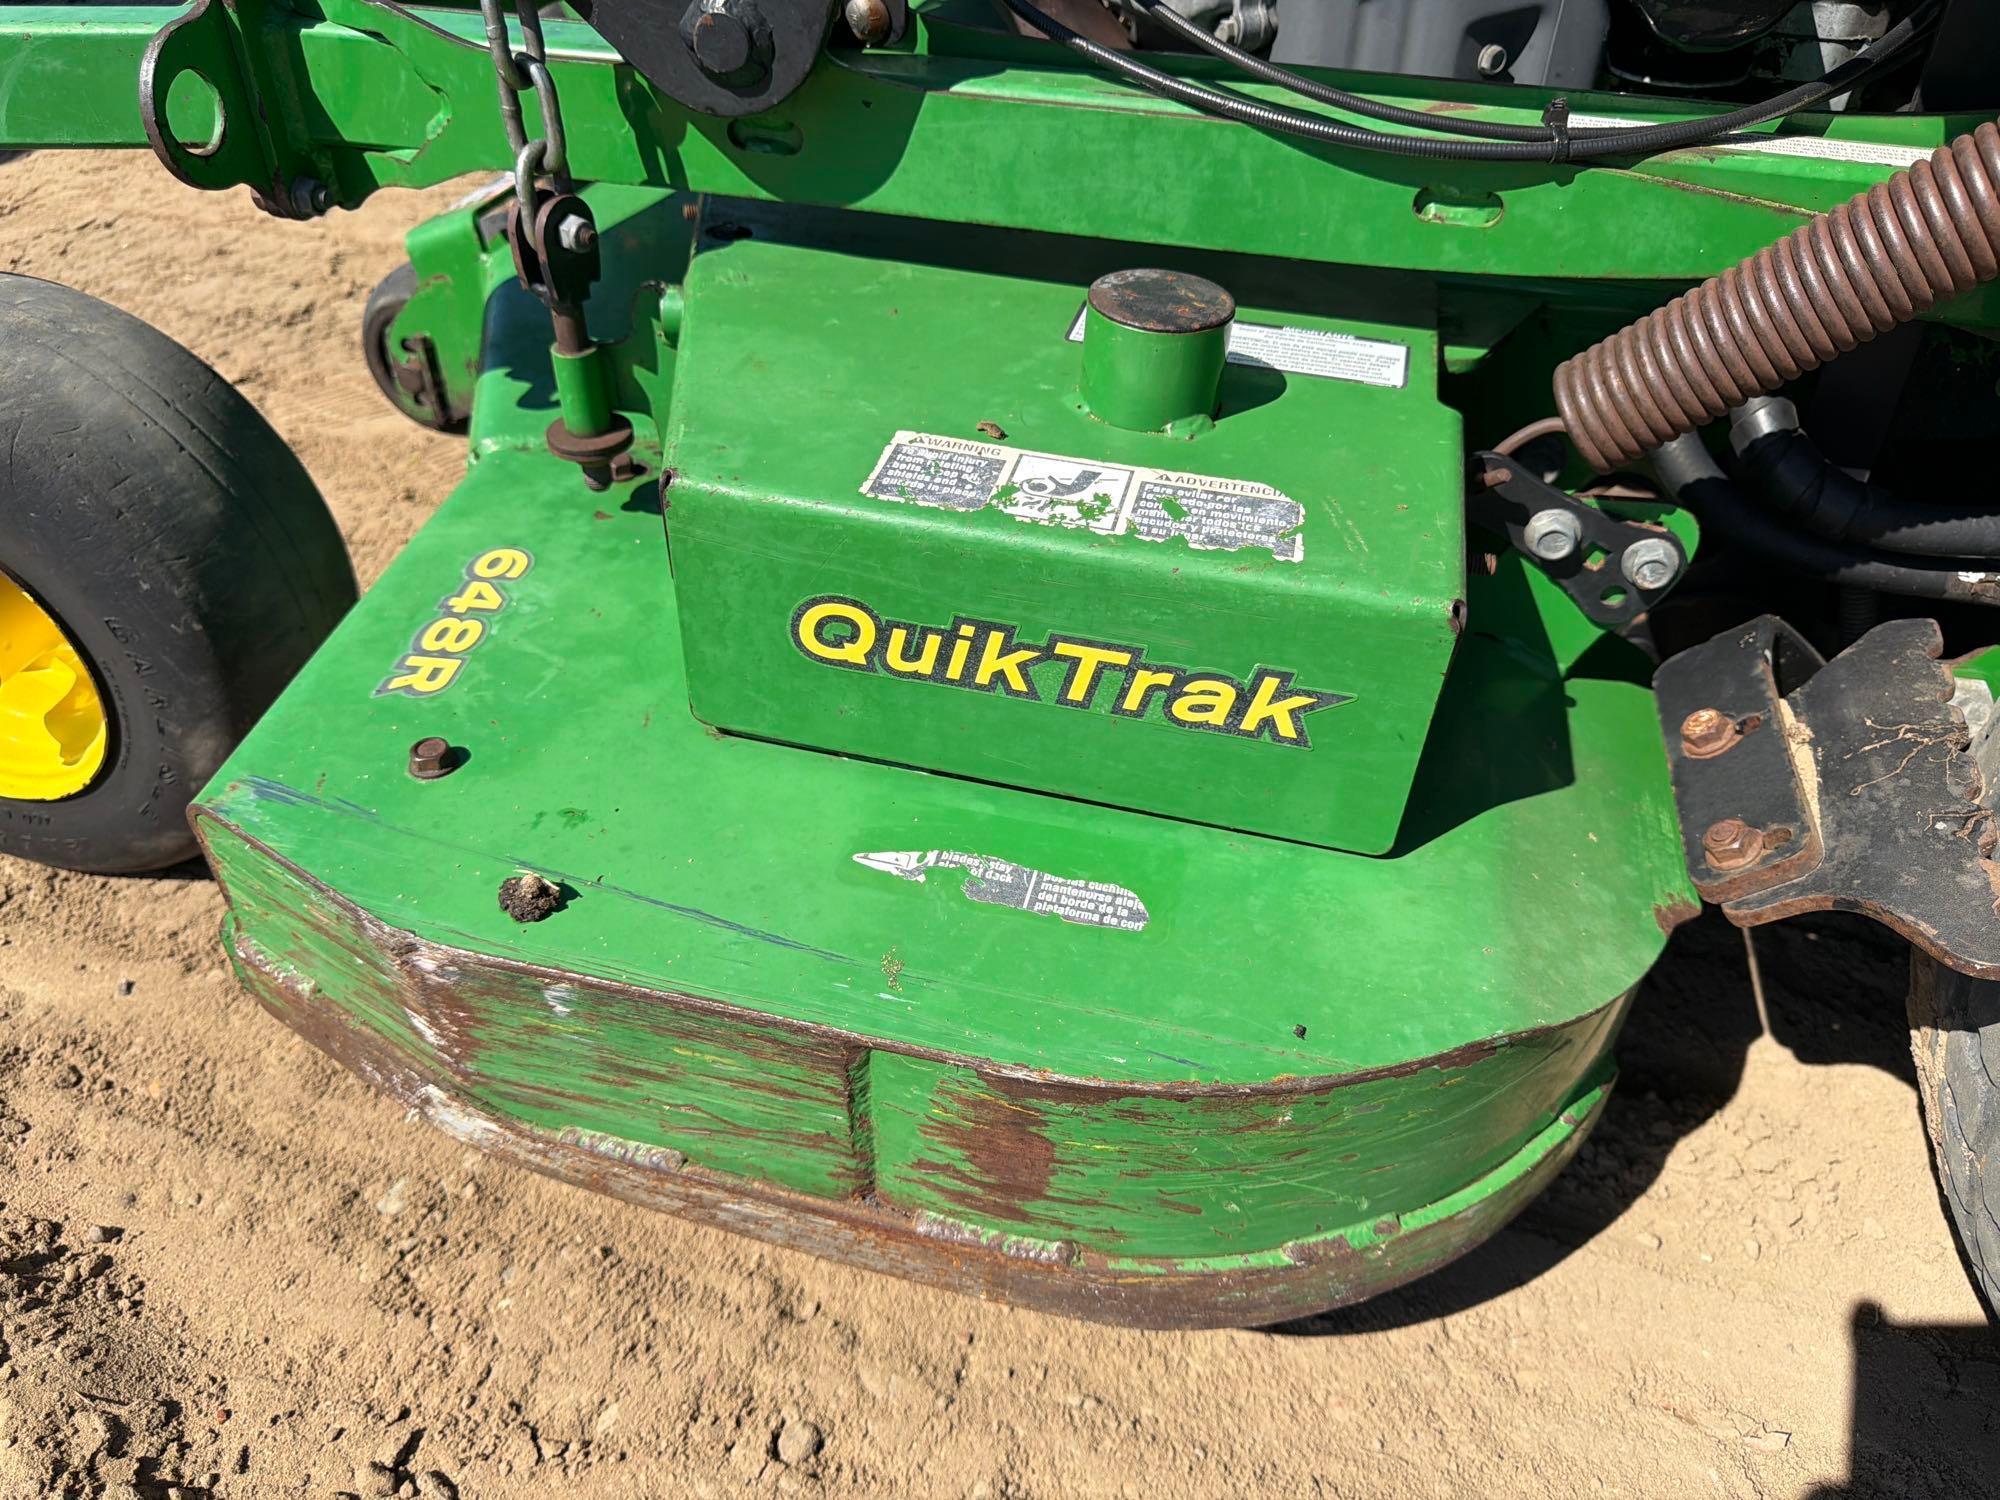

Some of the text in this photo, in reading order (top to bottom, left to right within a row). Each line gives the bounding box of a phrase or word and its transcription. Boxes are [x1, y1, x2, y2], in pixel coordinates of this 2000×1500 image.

[928, 438, 1001, 457] WARNING
[896, 454, 924, 465] from
[886, 469, 958, 486] shields and
[927, 483, 940, 492] in
[1144, 484, 1173, 495] Para
[1177, 489, 1214, 500] evitar
[386, 546, 530, 694] 648R
[797, 600, 1319, 741] QuikTrak
[1033, 901, 1100, 922] plataforma
[1103, 914, 1118, 926] de
[1037, 891, 1128, 917] del borde de la
